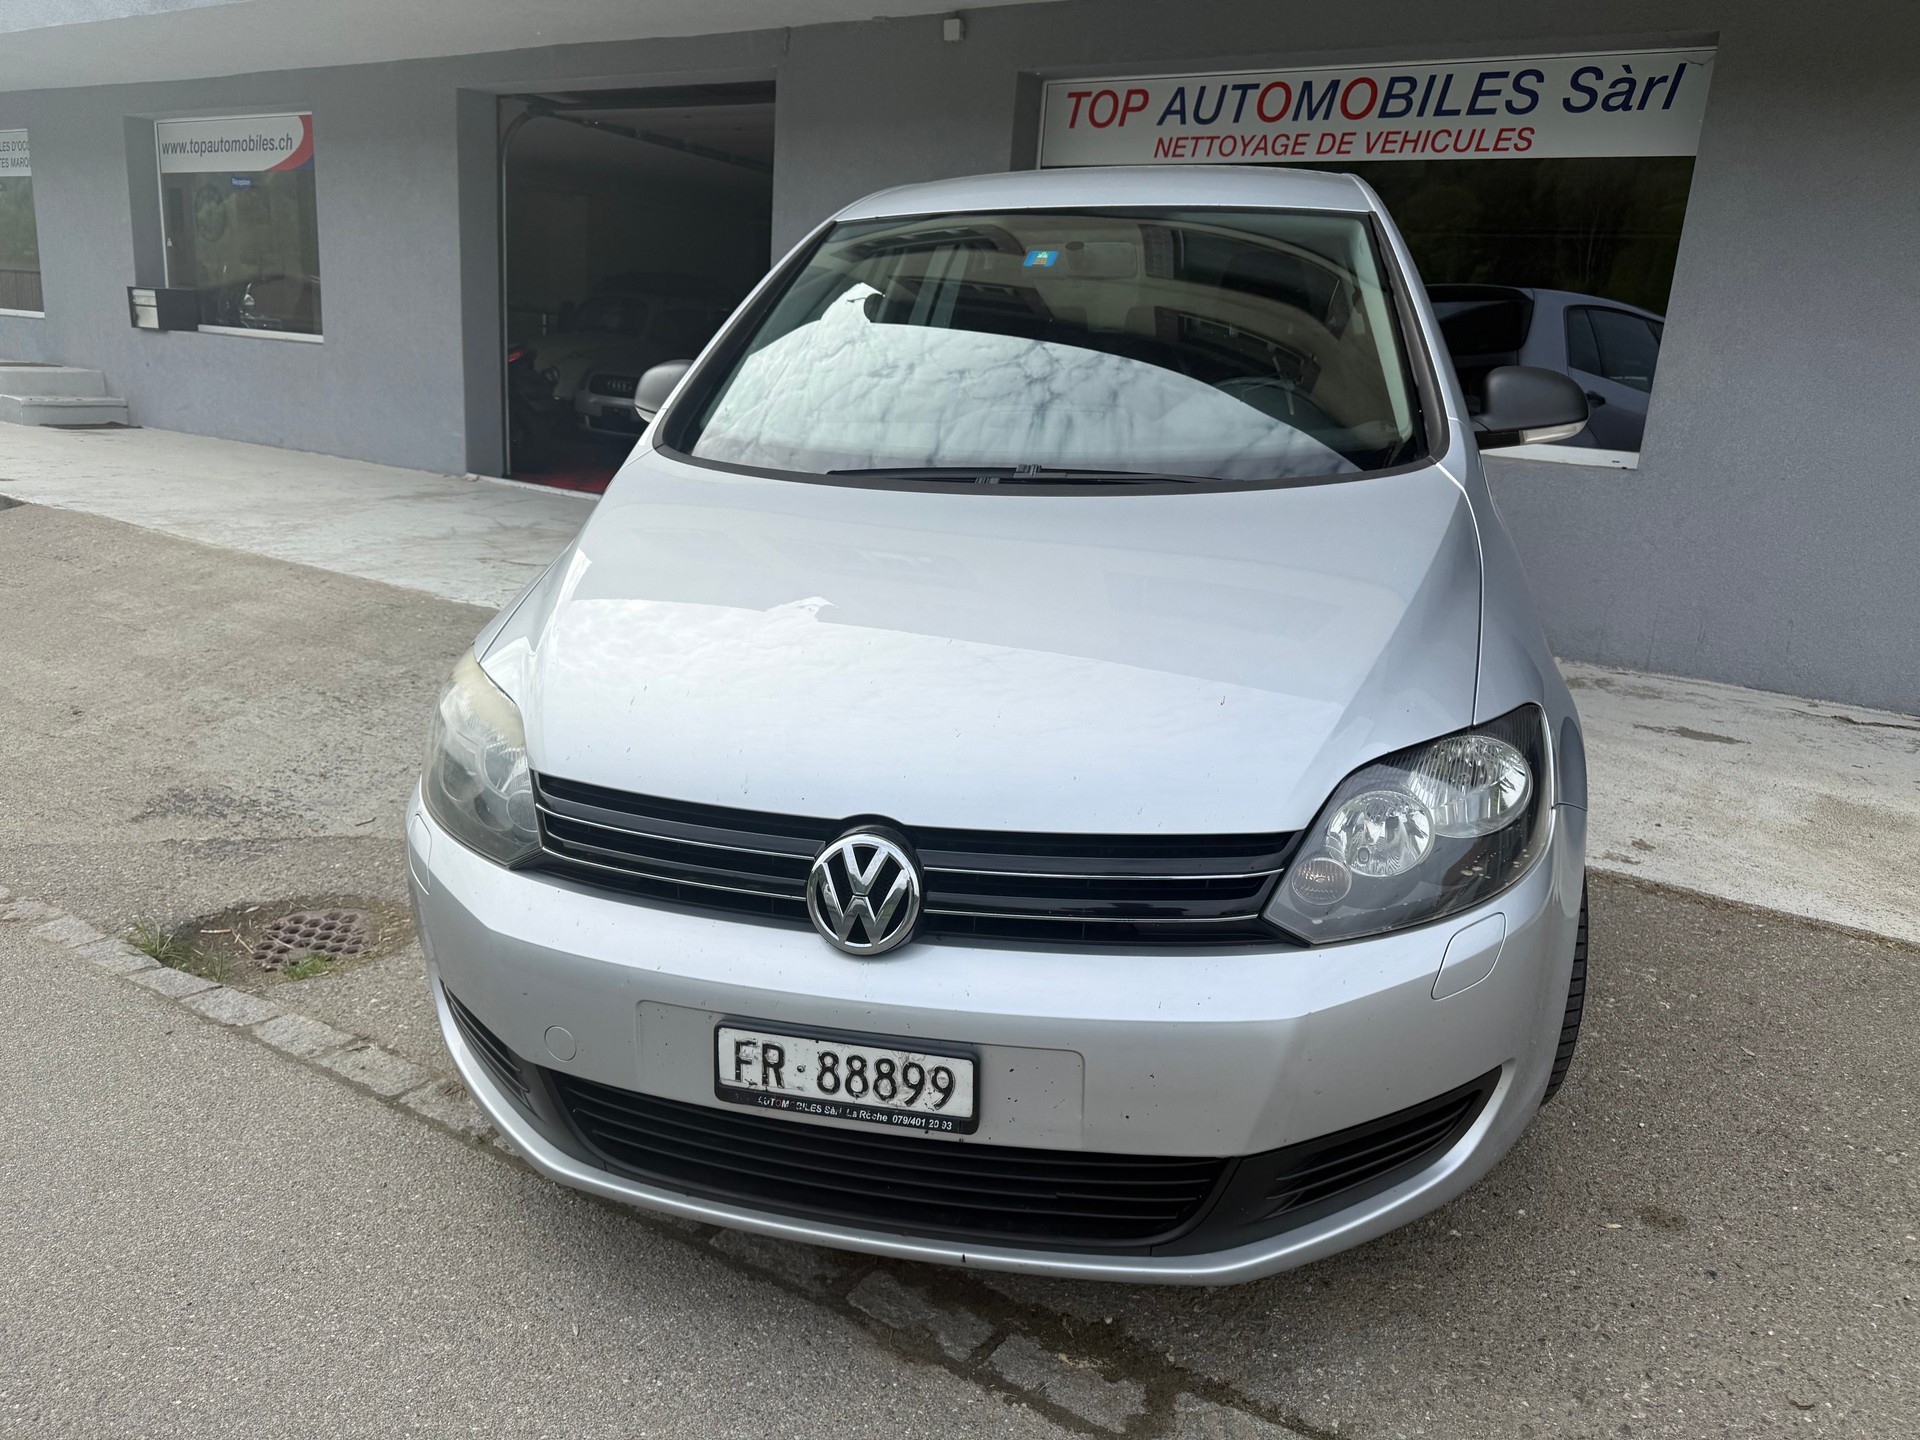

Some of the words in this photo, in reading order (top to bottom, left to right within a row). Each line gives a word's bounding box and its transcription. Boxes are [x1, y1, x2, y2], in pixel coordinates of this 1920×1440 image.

[1066, 88, 1149, 129] TOP
[1156, 68, 1545, 127] AUTOMOBILES
[1562, 62, 1687, 114] Sàrl
[162, 133, 293, 157] www.topautomobiles.ch
[1153, 132, 1310, 159] NETTOYAGE
[1315, 131, 1357, 155] DE
[1365, 127, 1536, 155] VEHICULES
[735, 1037, 785, 1089] FR
[816, 1050, 956, 1111] 88899
[892, 1114, 926, 1127] 079/401
